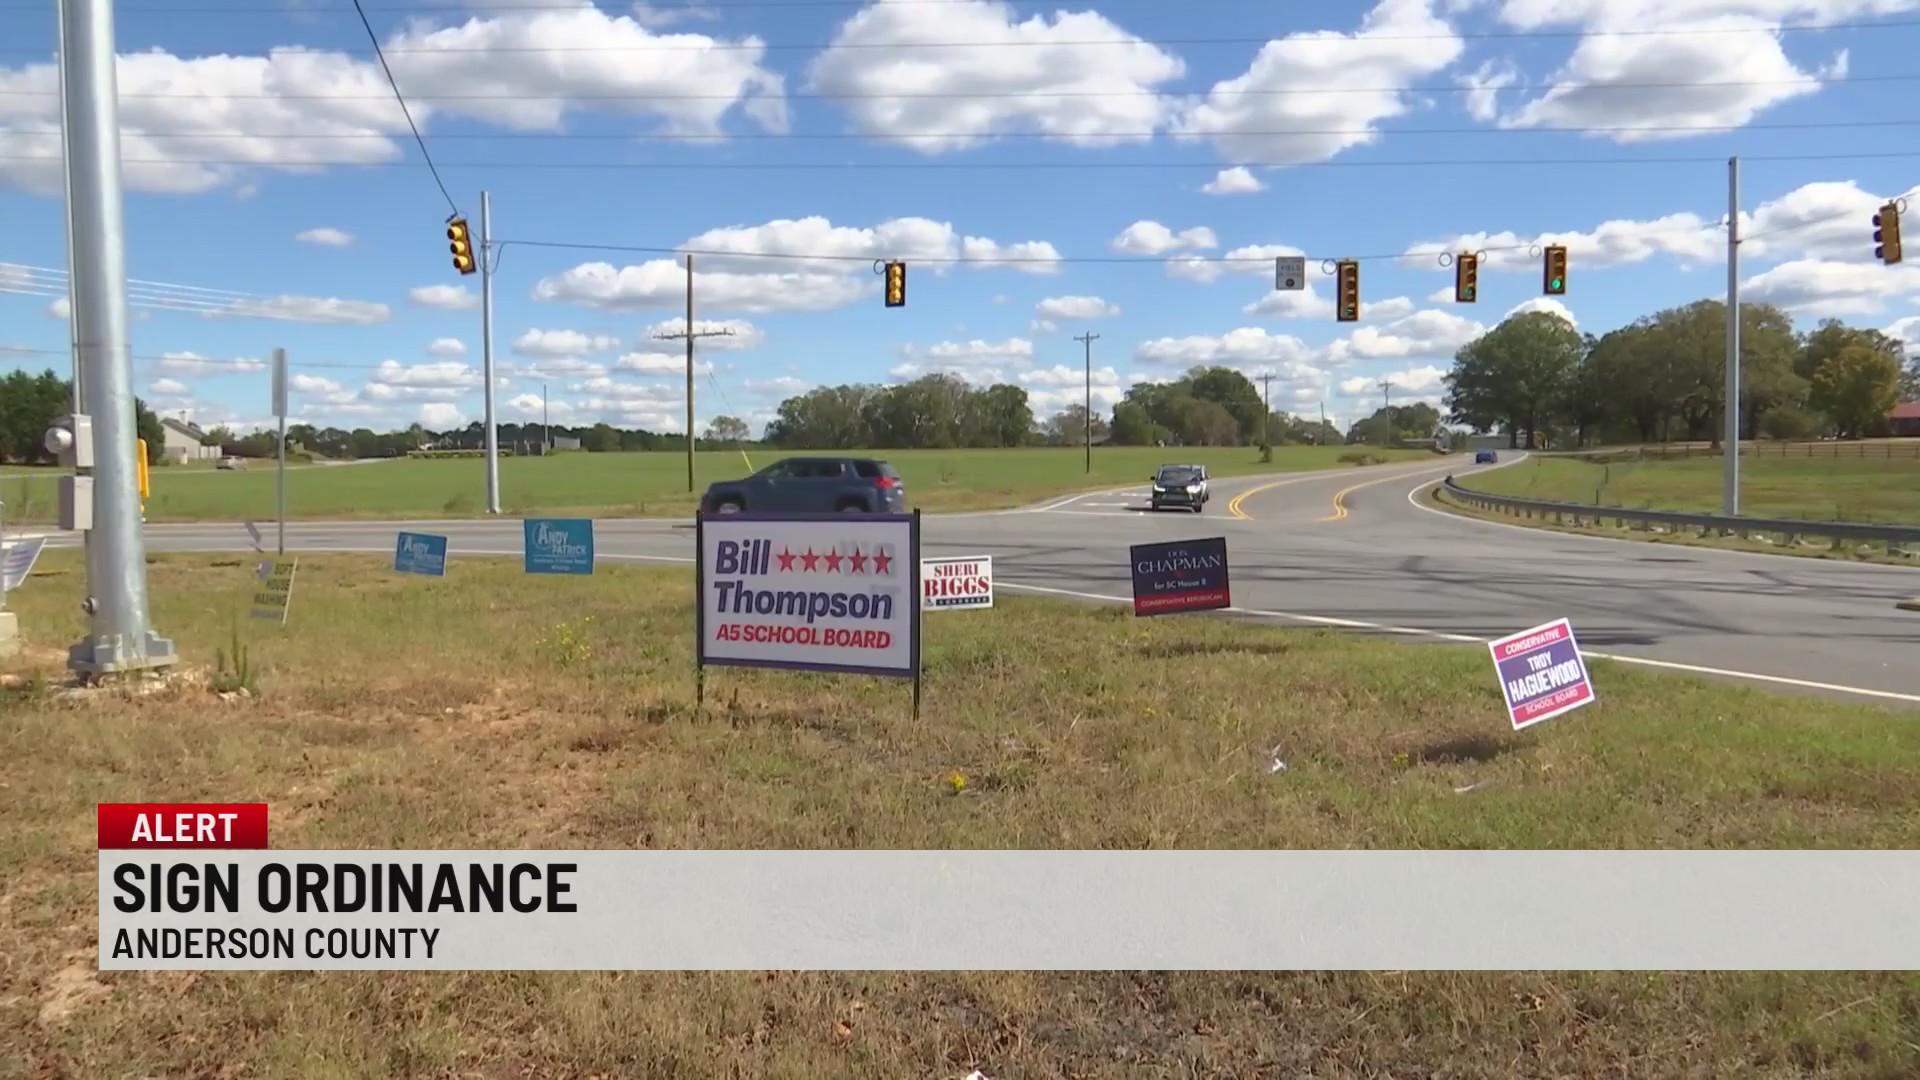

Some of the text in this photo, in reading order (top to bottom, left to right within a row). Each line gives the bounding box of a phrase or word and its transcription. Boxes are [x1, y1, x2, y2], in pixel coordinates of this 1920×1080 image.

[538, 522, 569, 545] ANDY
[715, 539, 772, 575] Bill
[1137, 554, 1221, 574] CHAPMAN
[934, 563, 979, 577] SHERI
[924, 576, 990, 597] BIGGS
[1166, 580, 1177, 589] SC
[714, 580, 893, 624] Thompson
[716, 623, 891, 649] A5 SCHOOL BOARD
[1505, 628, 1561, 655] CONSERVATIVE
[1527, 650, 1553, 671] TROY
[1508, 659, 1581, 703] HAGUEWOOD
[1525, 689, 1578, 714] SCHOOL BOARD
